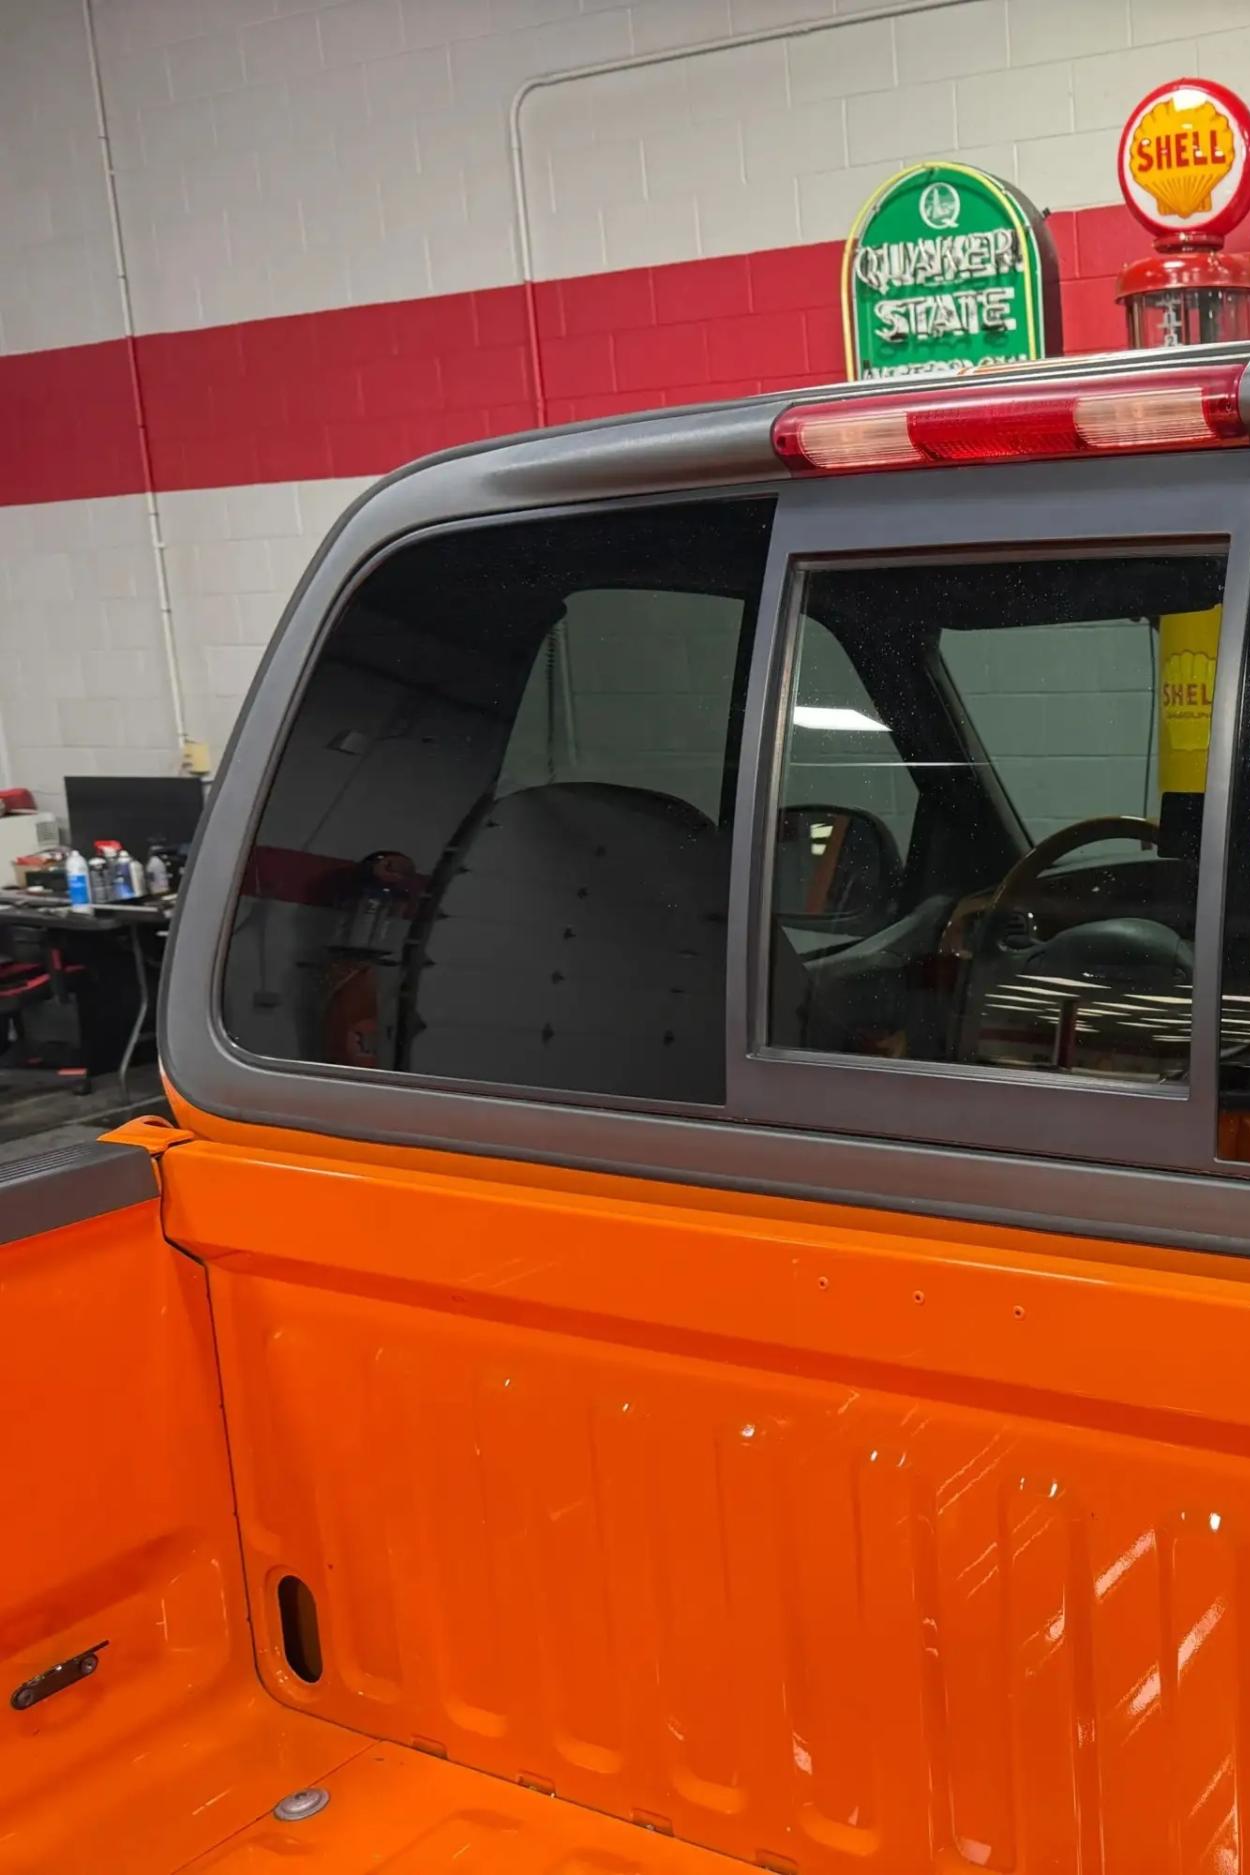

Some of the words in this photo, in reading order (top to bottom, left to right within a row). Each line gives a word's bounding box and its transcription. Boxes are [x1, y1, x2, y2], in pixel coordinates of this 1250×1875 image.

[1136, 129, 1227, 172] SHELL
[855, 229, 1024, 294] QUAKER
[873, 288, 1017, 341] STATE
[1163, 683, 1212, 706] SHEL
